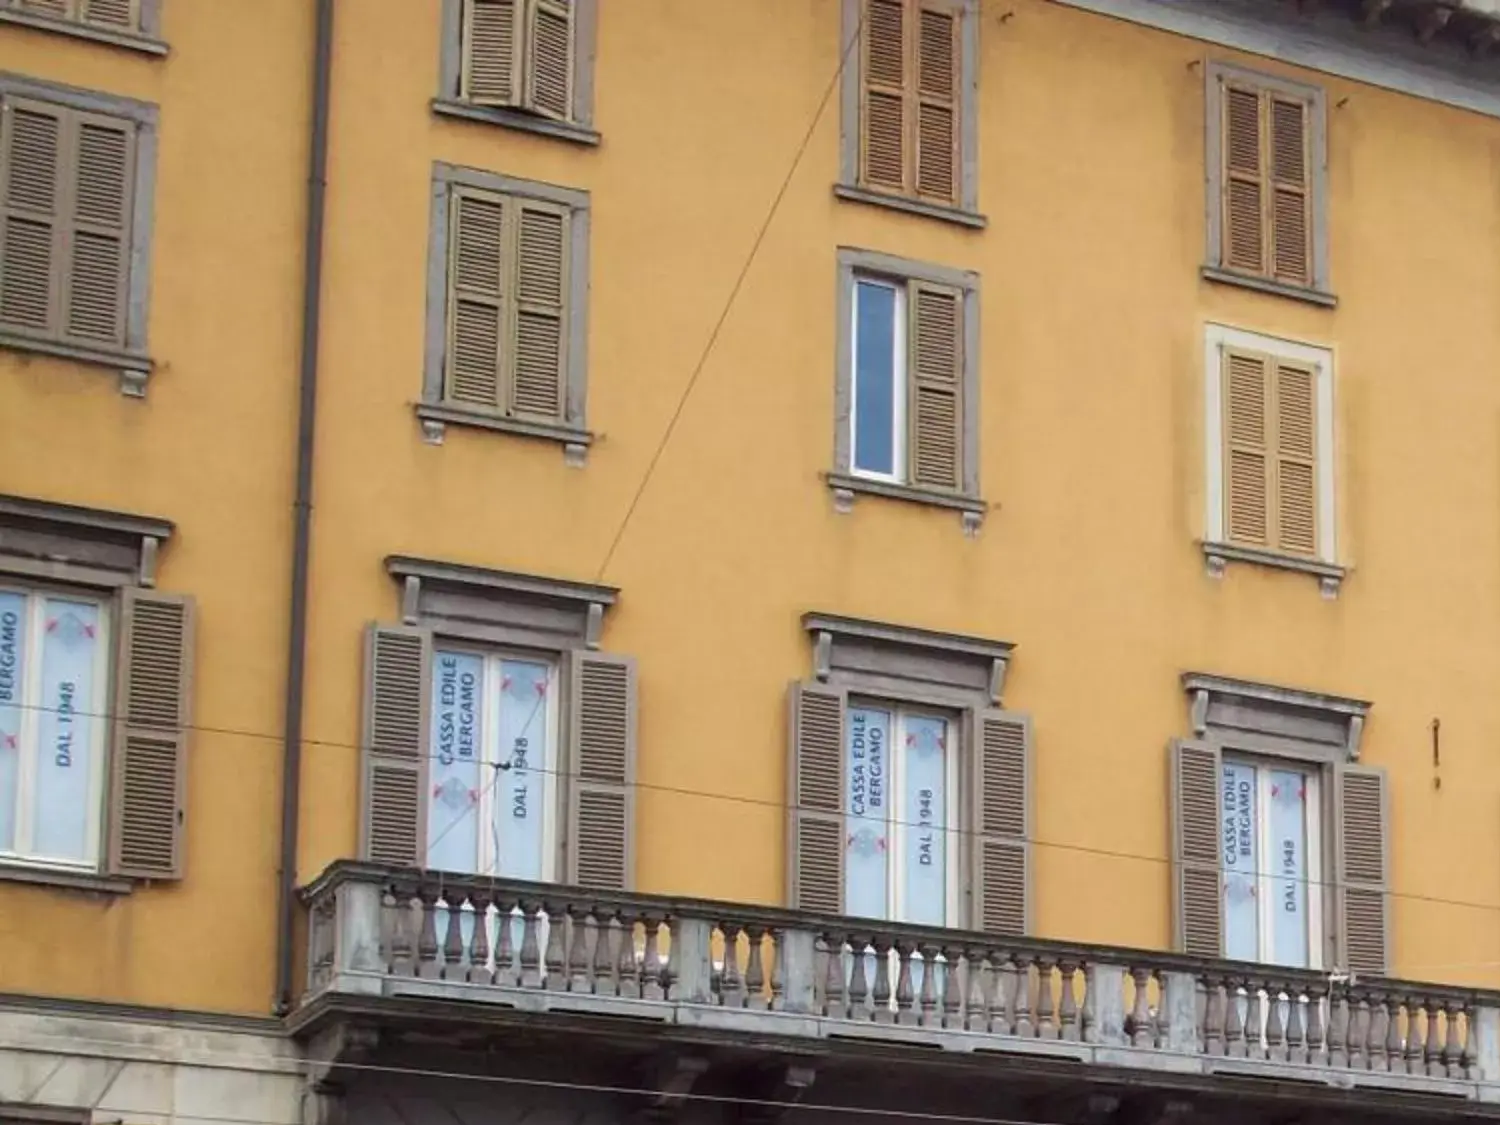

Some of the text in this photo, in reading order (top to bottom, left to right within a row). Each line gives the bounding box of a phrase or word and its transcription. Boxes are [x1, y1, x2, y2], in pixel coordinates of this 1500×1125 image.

[56, 681, 75, 768] DAL 1948
[439, 656, 458, 766] CASSA EDILE
[459, 671, 475, 757] BERGAMO
[513, 737, 529, 819] DAL 1948
[851, 713, 867, 816] CASSA EDILE
[868, 726, 883, 808] BERGAMO
[919, 789, 933, 866] DAL 1948
[1224, 766, 1237, 866] CASSA EDILE
[1238, 781, 1252, 857] BERGAMO
[1283, 839, 1297, 913] DAL 1948
